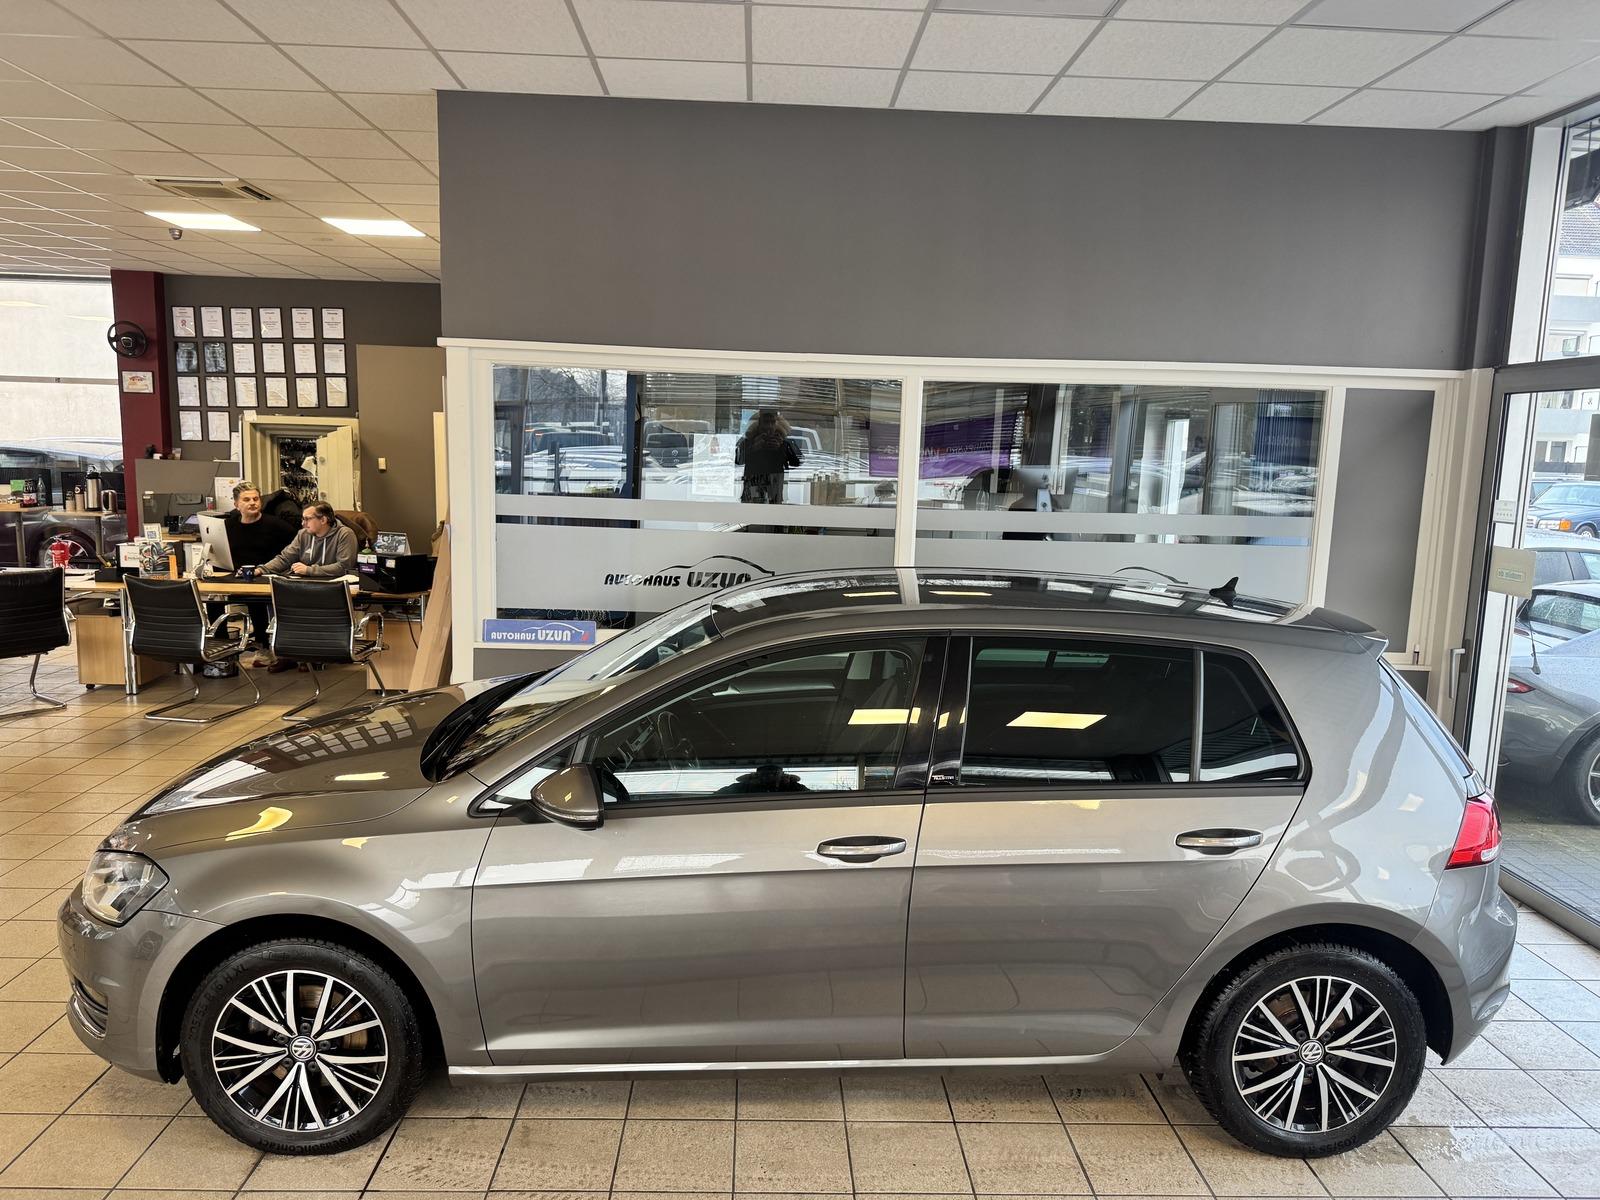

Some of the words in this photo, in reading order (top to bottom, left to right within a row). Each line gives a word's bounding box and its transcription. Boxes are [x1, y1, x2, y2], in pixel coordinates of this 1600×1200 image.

[604, 573, 681, 587] AUTOHAUS
[491, 631, 536, 641] AUTOHAUS
[537, 629, 571, 641] UZUN
